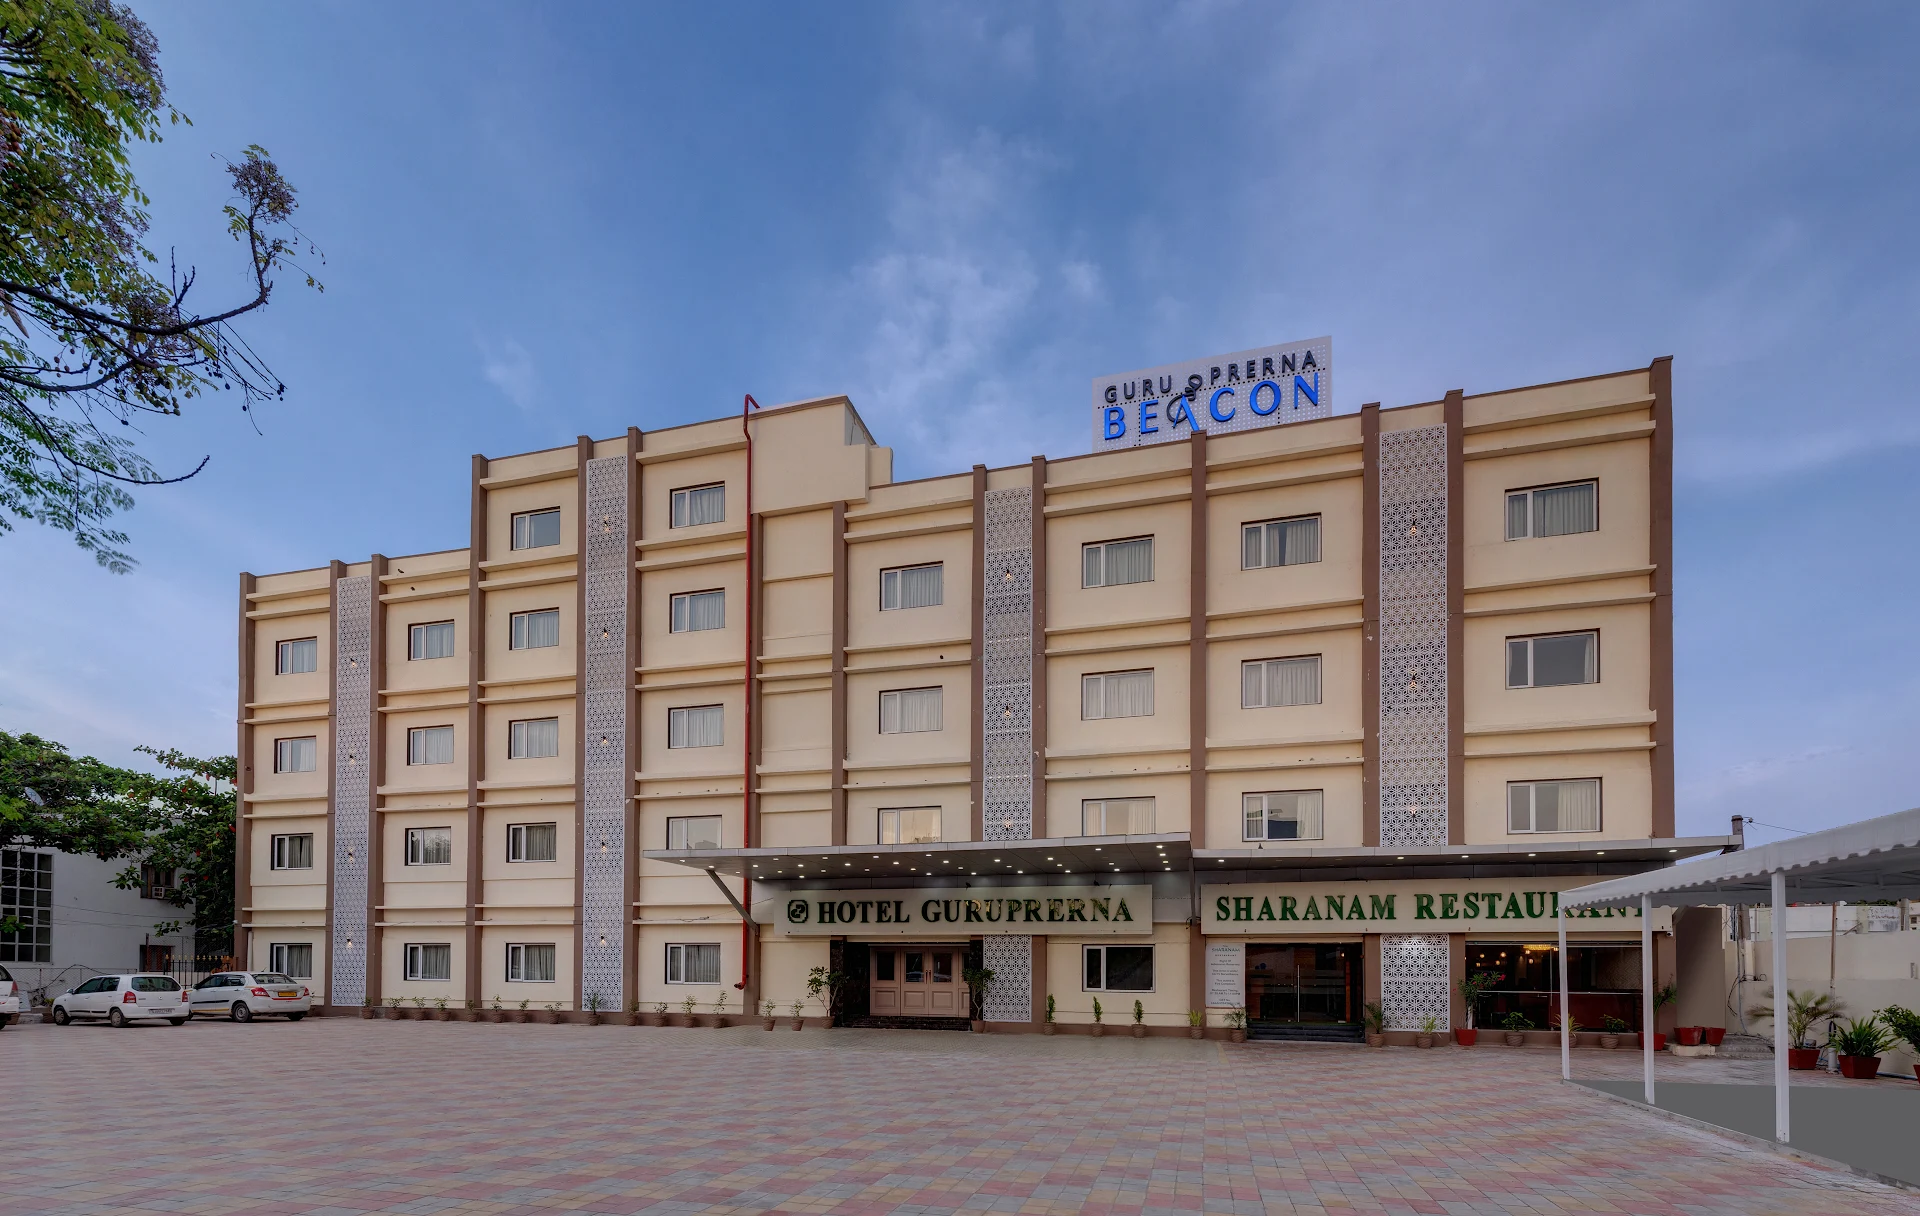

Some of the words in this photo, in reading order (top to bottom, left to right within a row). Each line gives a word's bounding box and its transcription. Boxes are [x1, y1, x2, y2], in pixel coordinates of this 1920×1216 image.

[1104, 374, 1172, 404] GURU
[1210, 350, 1317, 386] PRERNA
[1103, 372, 1319, 441] BEACON
[816, 900, 910, 924] HOTEL
[920, 898, 1134, 923] GURUPRERNA
[1215, 894, 1397, 922] SHARANAM
[1413, 891, 1643, 920] RESTAU
